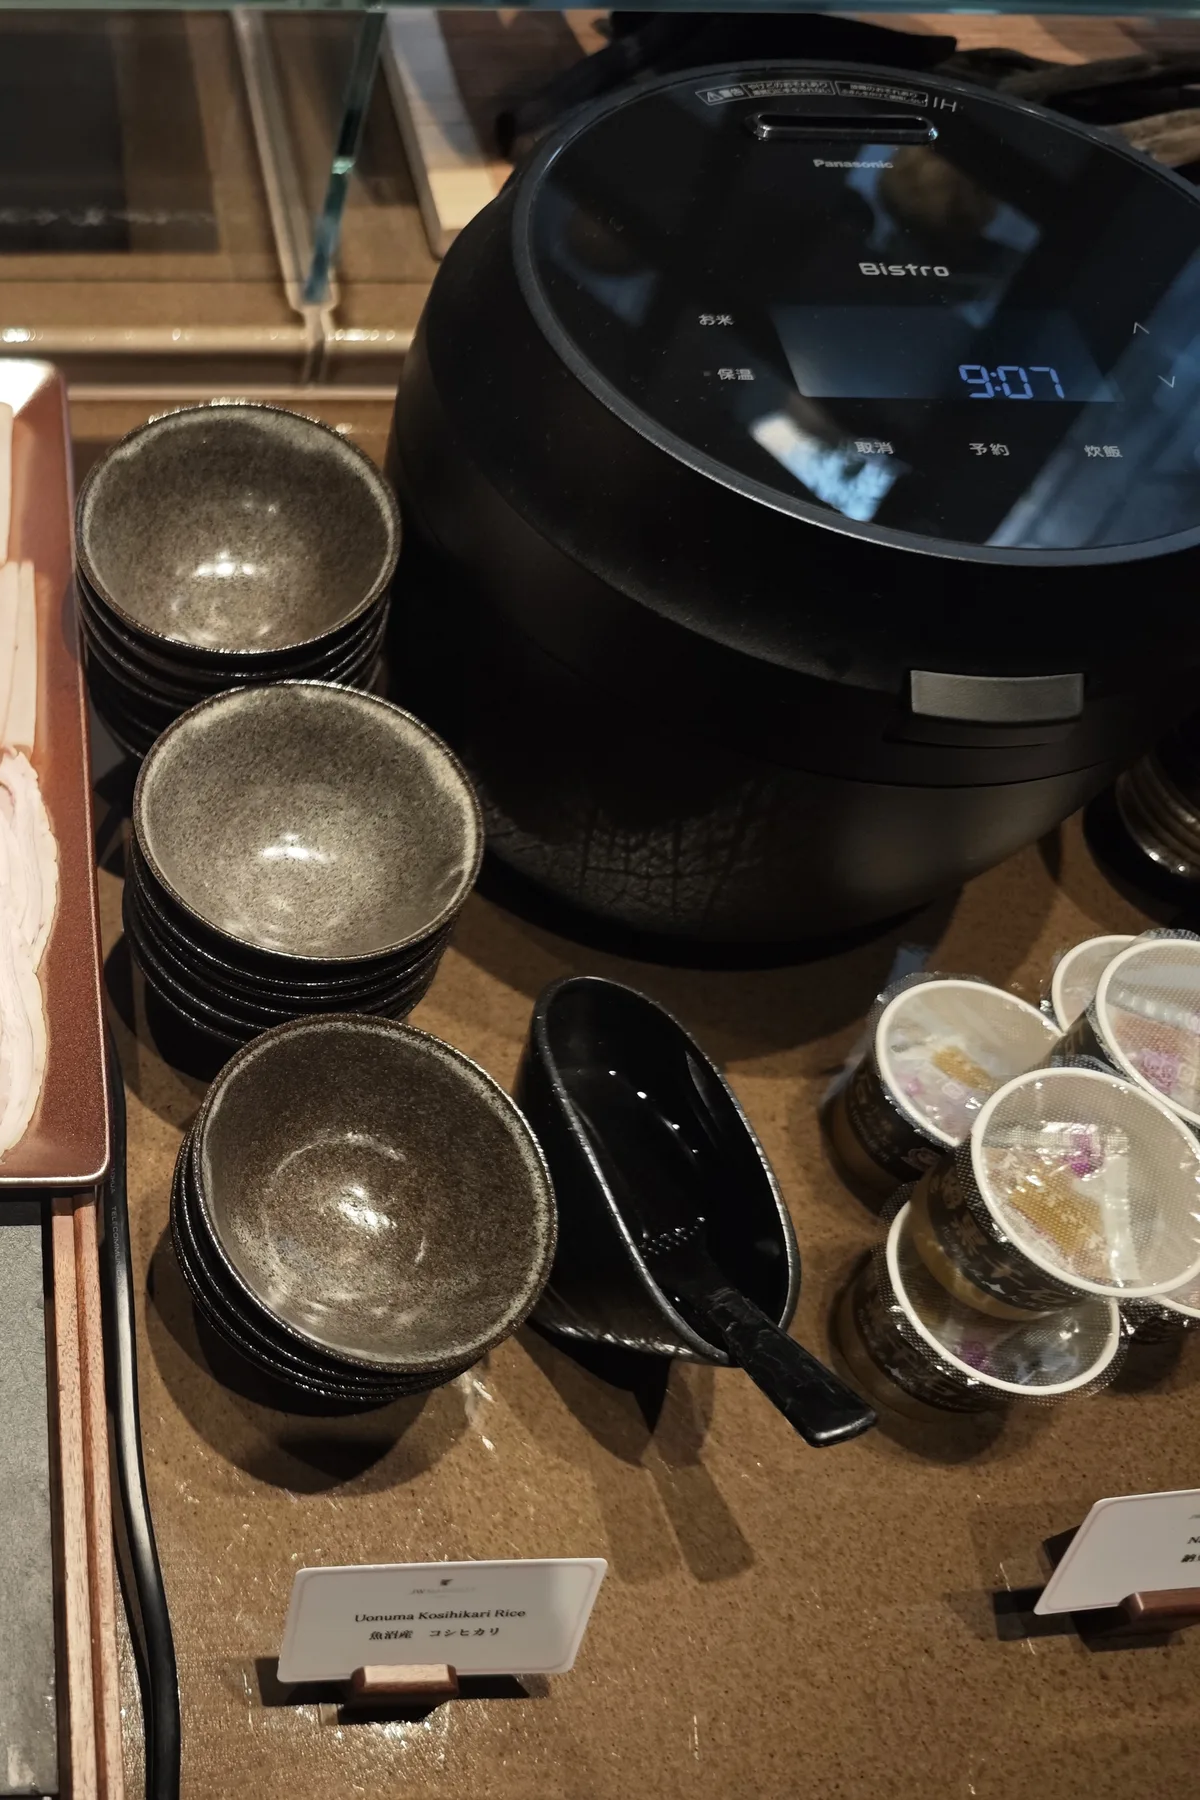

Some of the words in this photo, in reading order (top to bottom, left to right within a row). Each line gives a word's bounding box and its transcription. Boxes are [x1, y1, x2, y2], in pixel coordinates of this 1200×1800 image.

[933, 96, 957, 112] IH
[813, 158, 894, 169] Panasonic
[858, 262, 950, 277] Bistro
[698, 314, 734, 326] お米
[717, 368, 755, 381] 保温
[958, 364, 1065, 400] 9:07
[854, 440, 895, 455] 取消
[969, 442, 1010, 457] 予約
[1084, 444, 1124, 459] 炊飯
[354, 1613, 414, 1623] Uonuma
[418, 1609, 491, 1621] Kosihikari
[494, 1608, 526, 1618] Rice
[369, 1630, 414, 1641] 魚沼産
[429, 1627, 500, 1638] コシヒカリ
